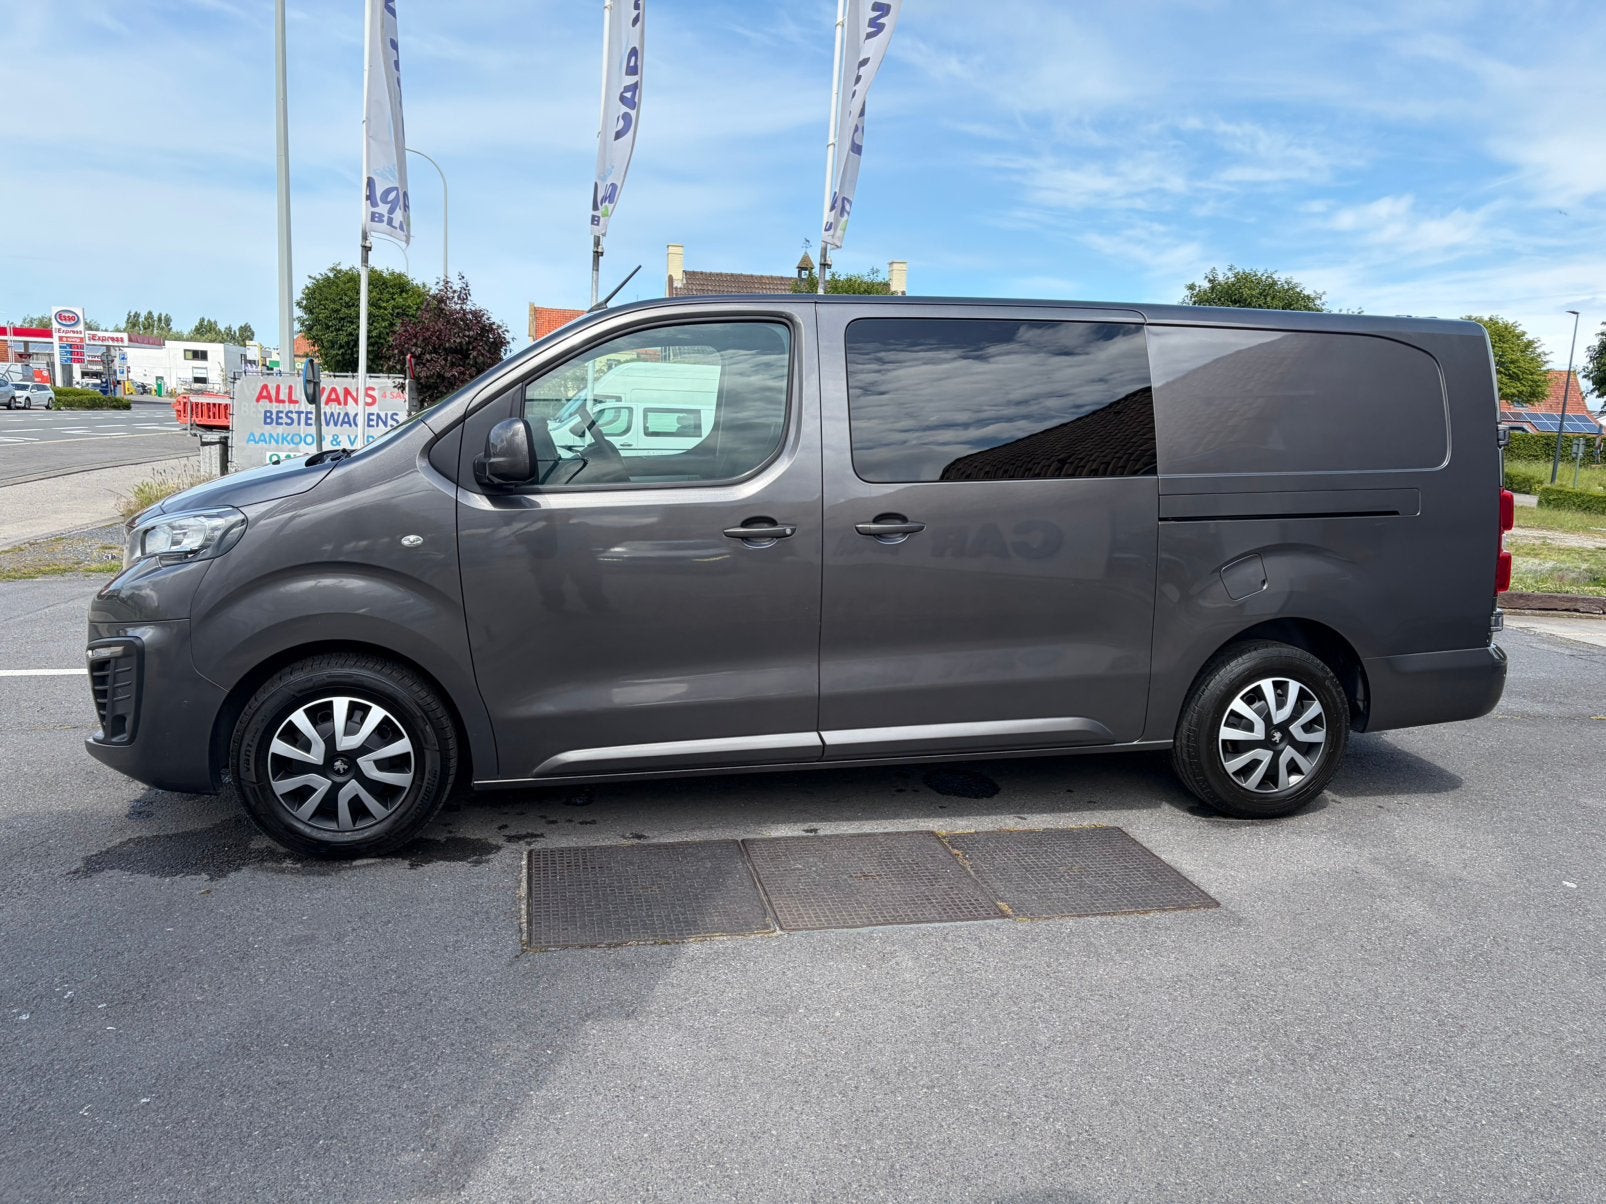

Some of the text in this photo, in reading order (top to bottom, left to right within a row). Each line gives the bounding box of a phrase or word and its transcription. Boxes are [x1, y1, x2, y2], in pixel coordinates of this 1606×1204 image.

[91, 333, 125, 343] Express
[255, 383, 300, 405] ALL
[263, 410, 400, 428] BESTEWAENS
